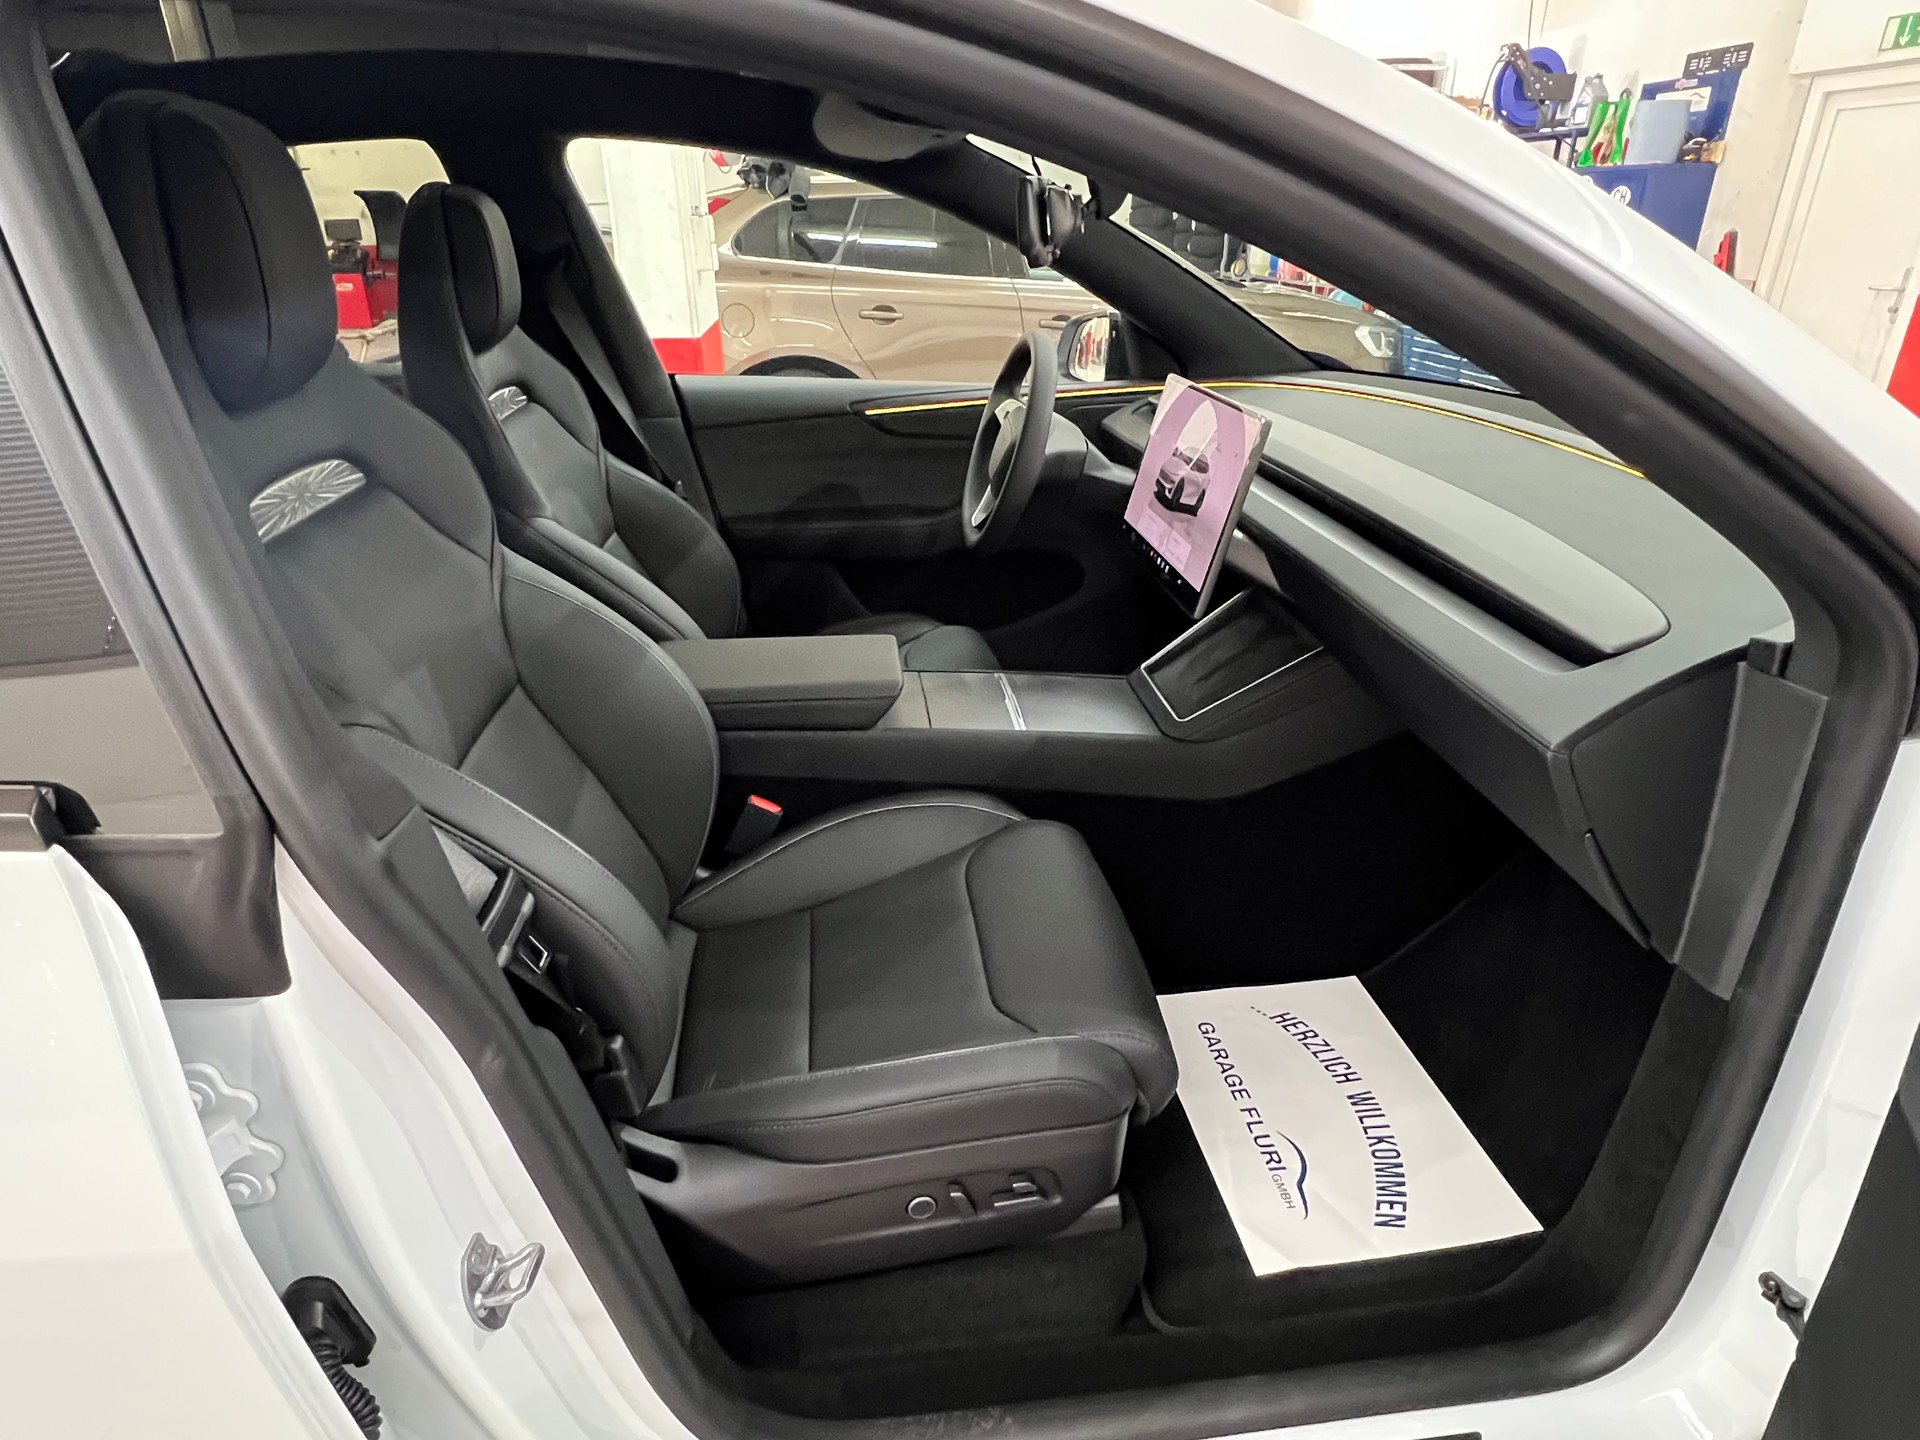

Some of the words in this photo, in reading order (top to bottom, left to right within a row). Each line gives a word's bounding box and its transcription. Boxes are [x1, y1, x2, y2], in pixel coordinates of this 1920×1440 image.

[1198, 1022, 1251, 1101] GARAGE
[1240, 1106, 1286, 1171] FLURI
[1271, 1173, 1296, 1210] GMBH
[1346, 1090, 1407, 1228] WILLKOMMEN
